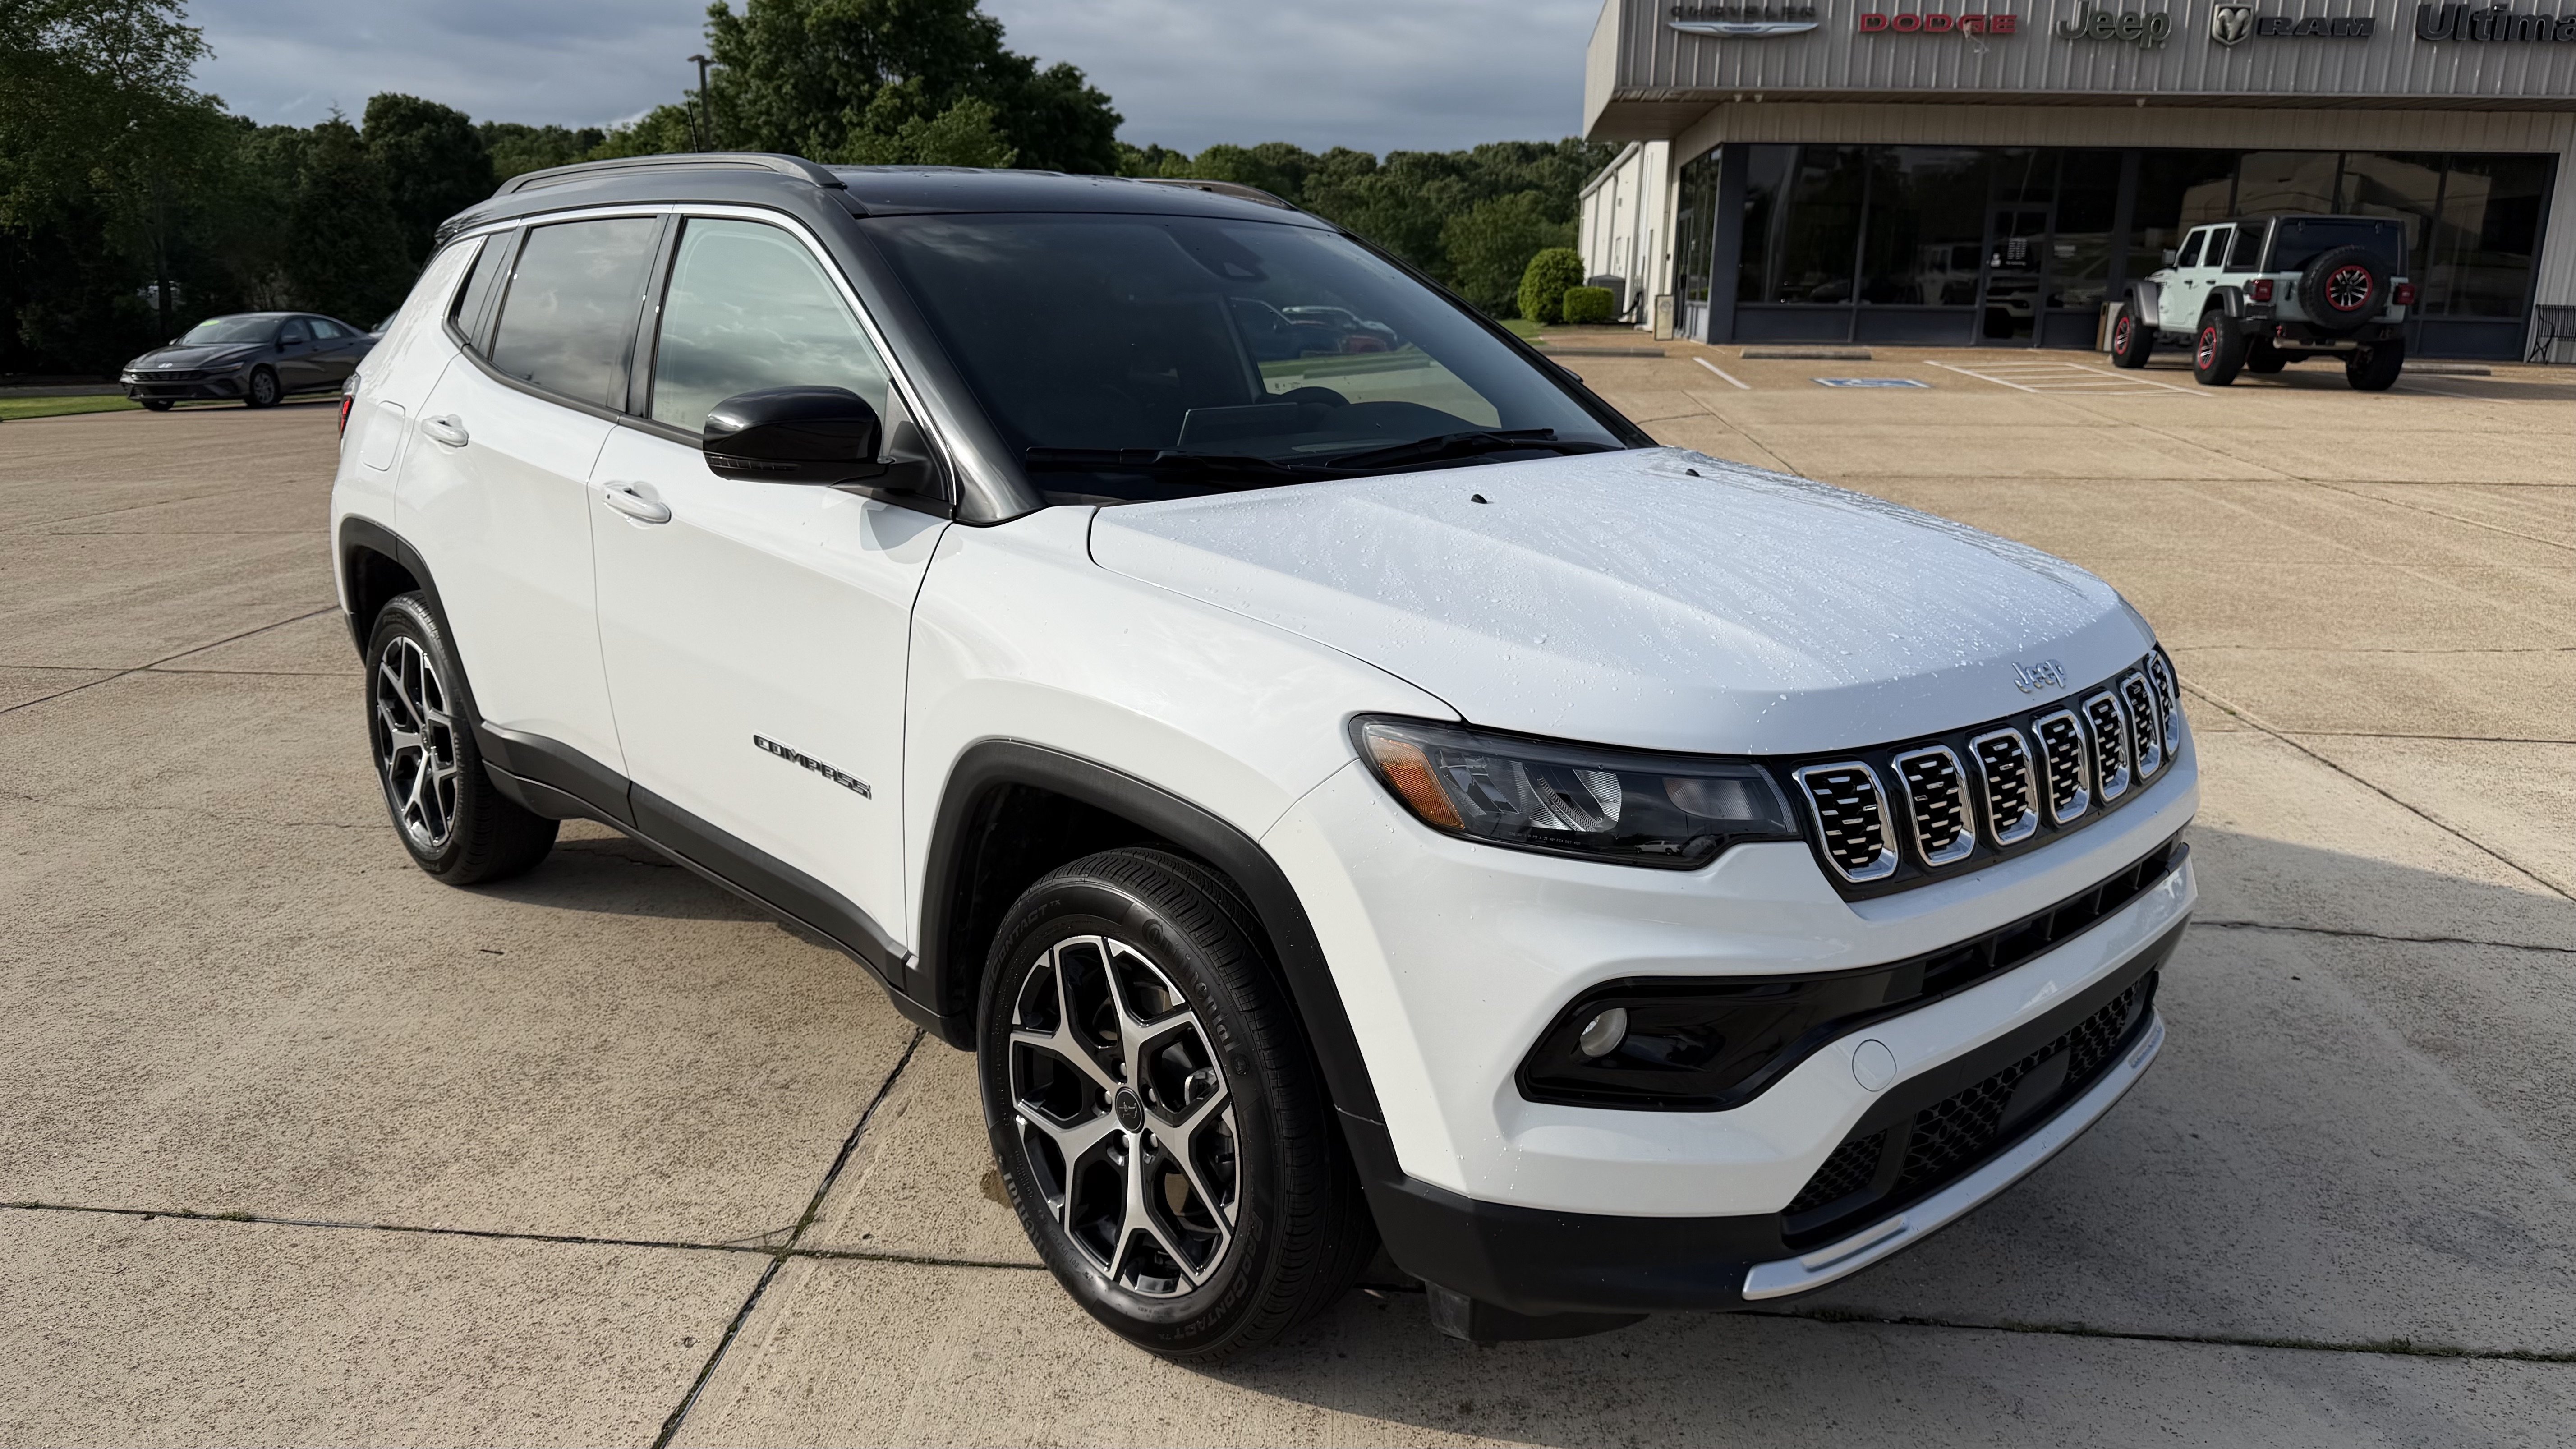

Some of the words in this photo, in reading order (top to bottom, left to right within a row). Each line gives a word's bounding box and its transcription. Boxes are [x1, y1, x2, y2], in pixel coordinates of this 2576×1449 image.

[1858, 14, 2017, 33] DODGE
[2056, 1, 2171, 48] Jeep
[2258, 17, 2376, 36] RAM
[2416, 3, 2576, 41] Ultima
[2011, 658, 2067, 693] Jeep
[753, 729, 872, 800] COMPASS
